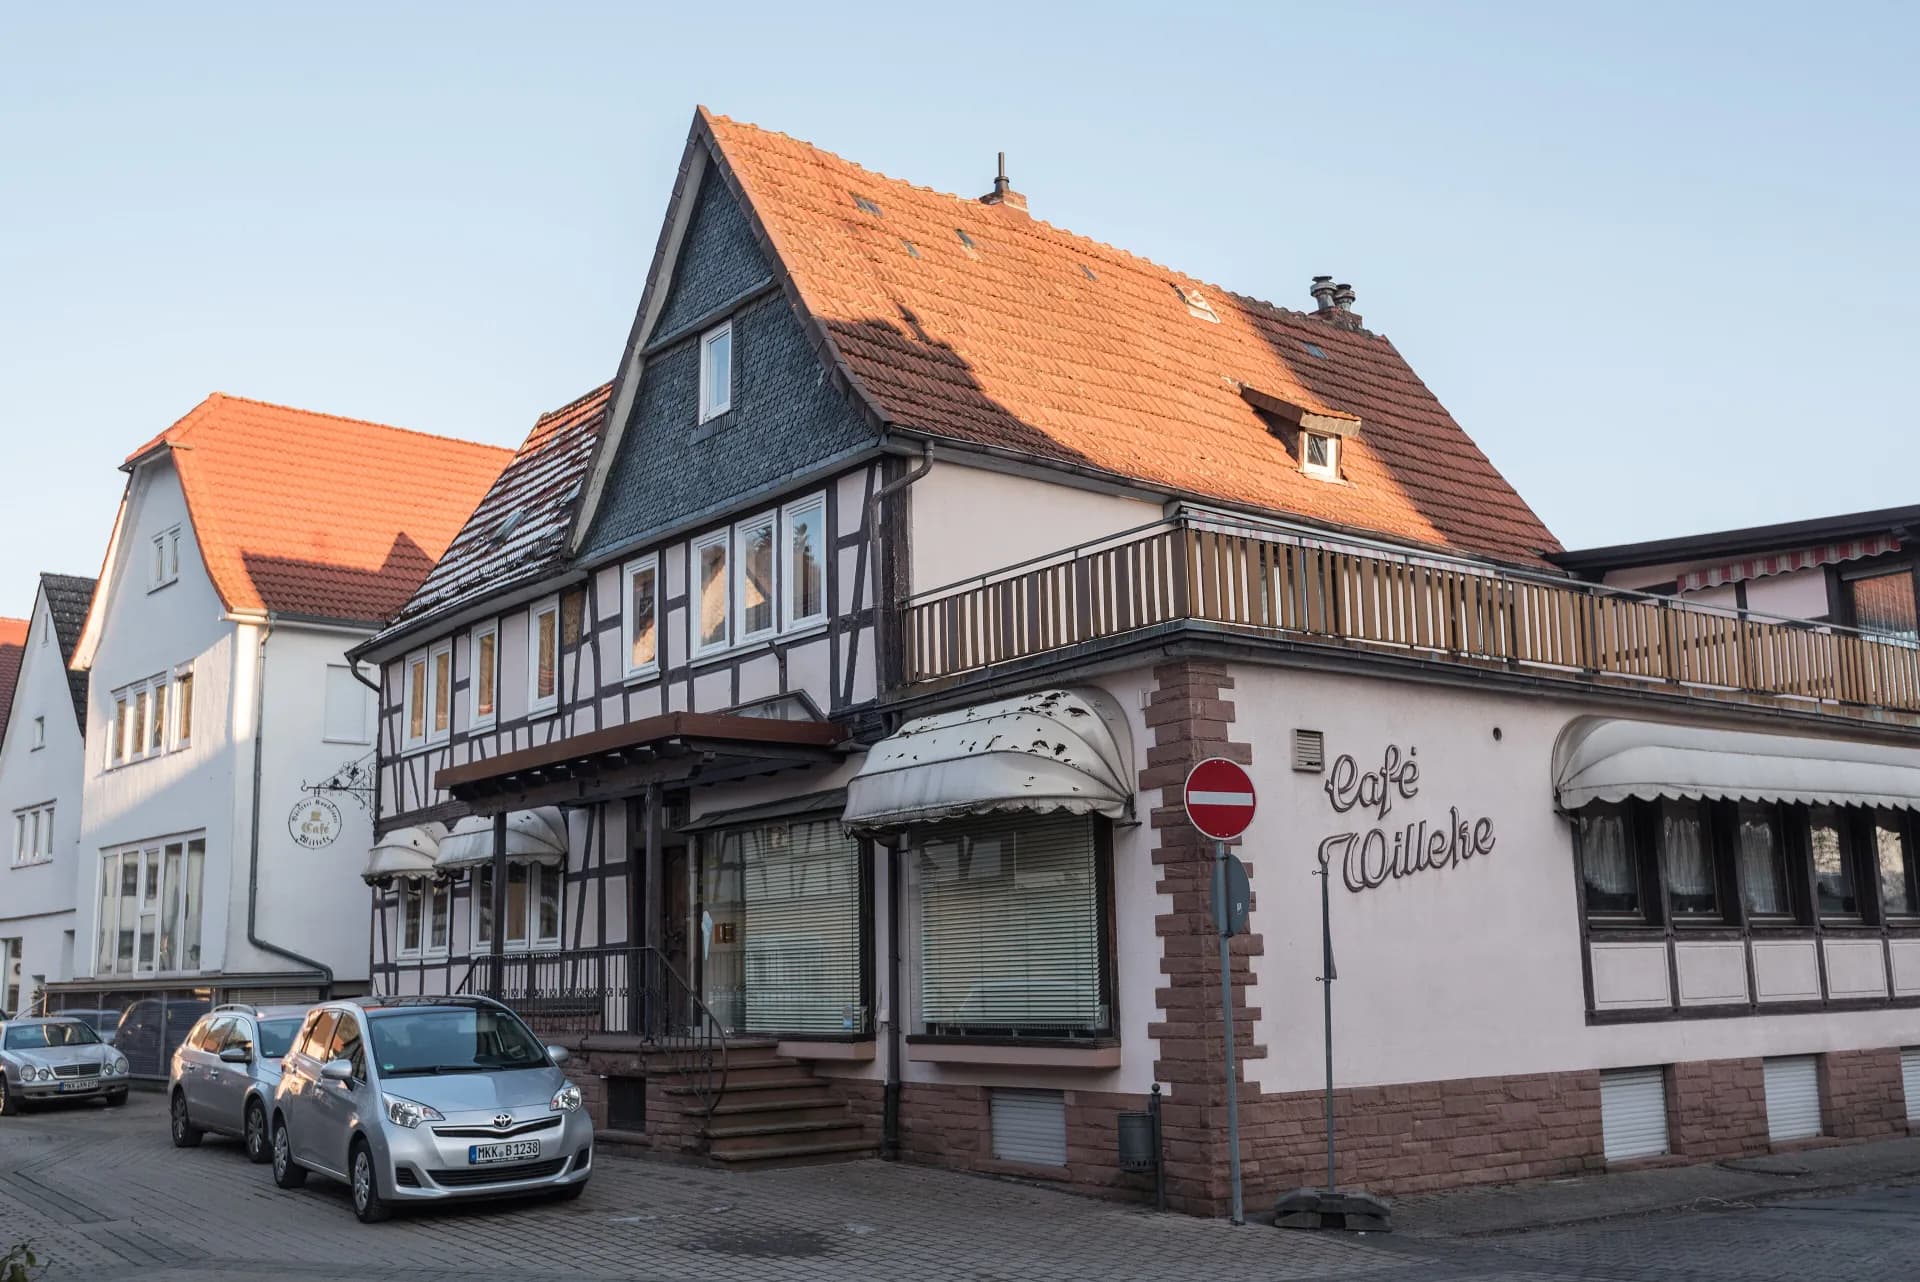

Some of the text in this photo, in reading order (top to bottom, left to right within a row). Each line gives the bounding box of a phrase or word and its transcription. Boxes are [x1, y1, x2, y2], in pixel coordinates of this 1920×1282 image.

[1325, 744, 1419, 820] Café
[301, 821, 330, 835] Café
[1318, 806, 1496, 893] Willeke
[478, 1145, 498, 1159] MKK
